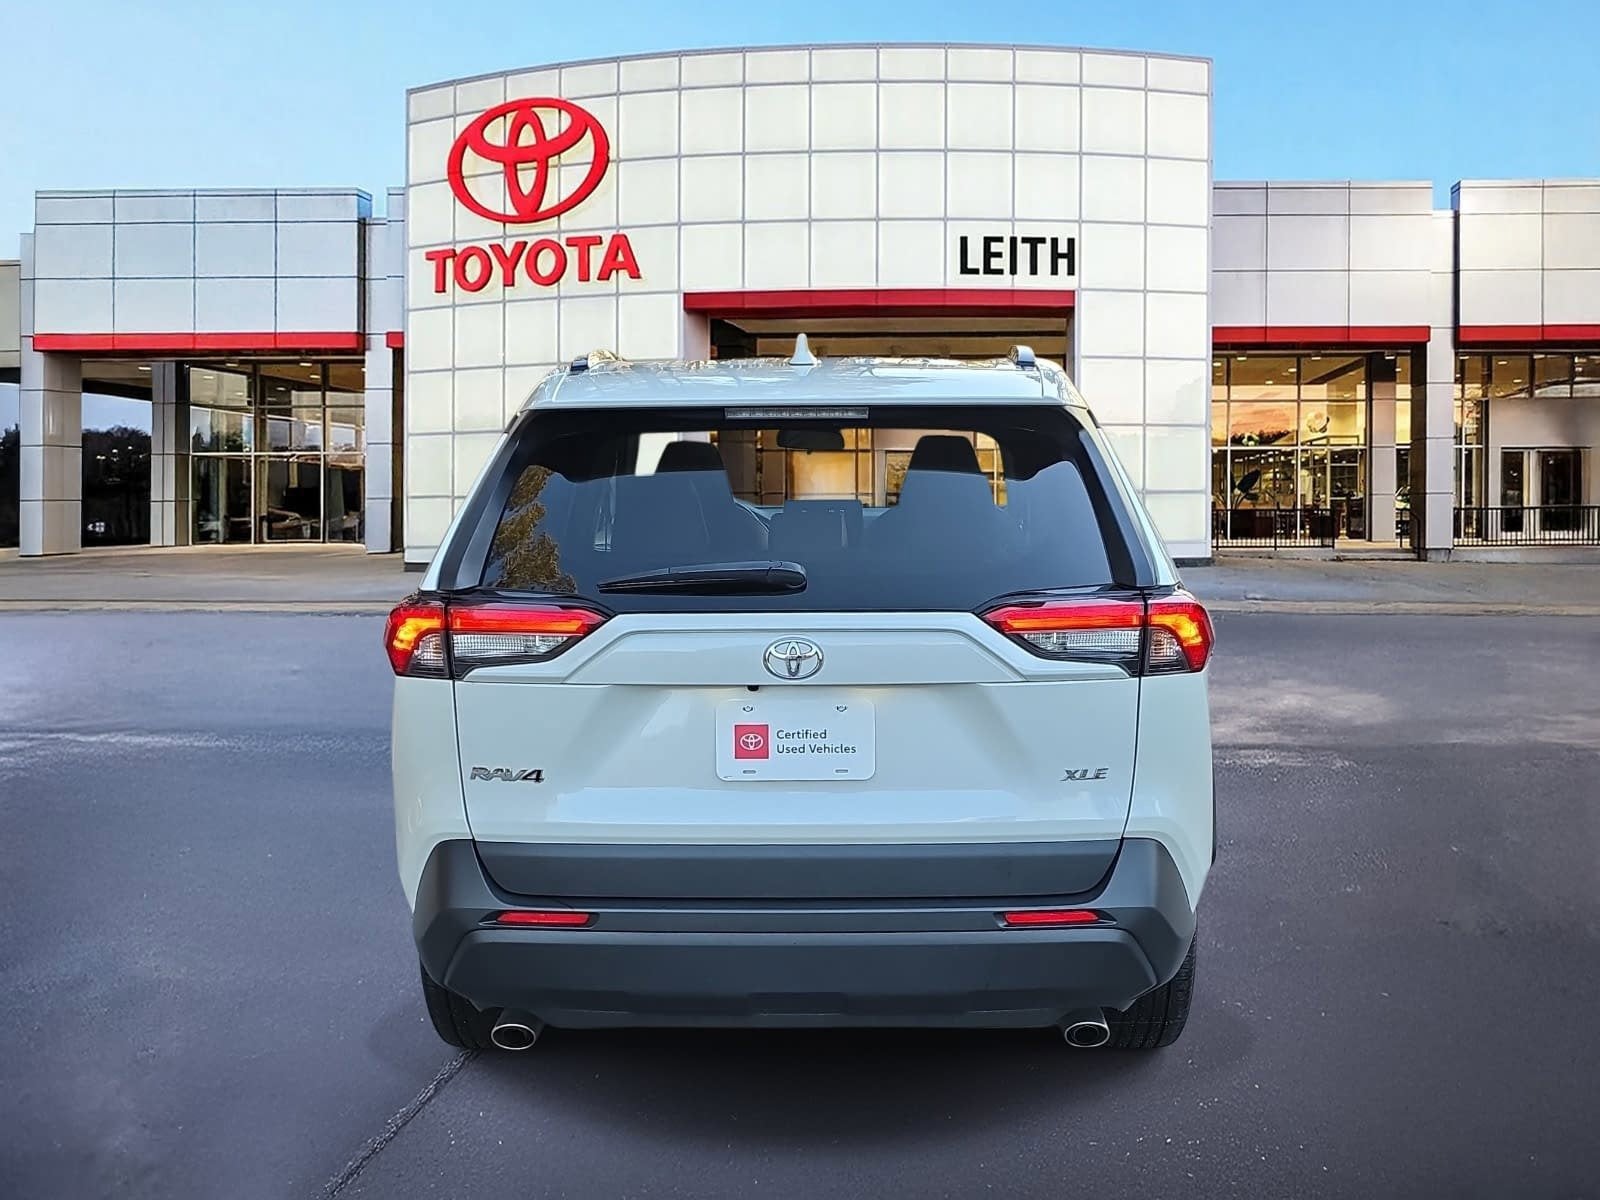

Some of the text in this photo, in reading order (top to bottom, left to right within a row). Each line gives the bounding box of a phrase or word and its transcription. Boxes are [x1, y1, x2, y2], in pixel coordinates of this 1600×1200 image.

[425, 233, 642, 293] TOYOTA
[959, 235, 1076, 276] LEITH
[776, 729, 827, 740] Certified
[776, 743, 857, 754] Used Vehicles
[470, 766, 545, 783] RAV4
[1061, 767, 1109, 781] XLE
